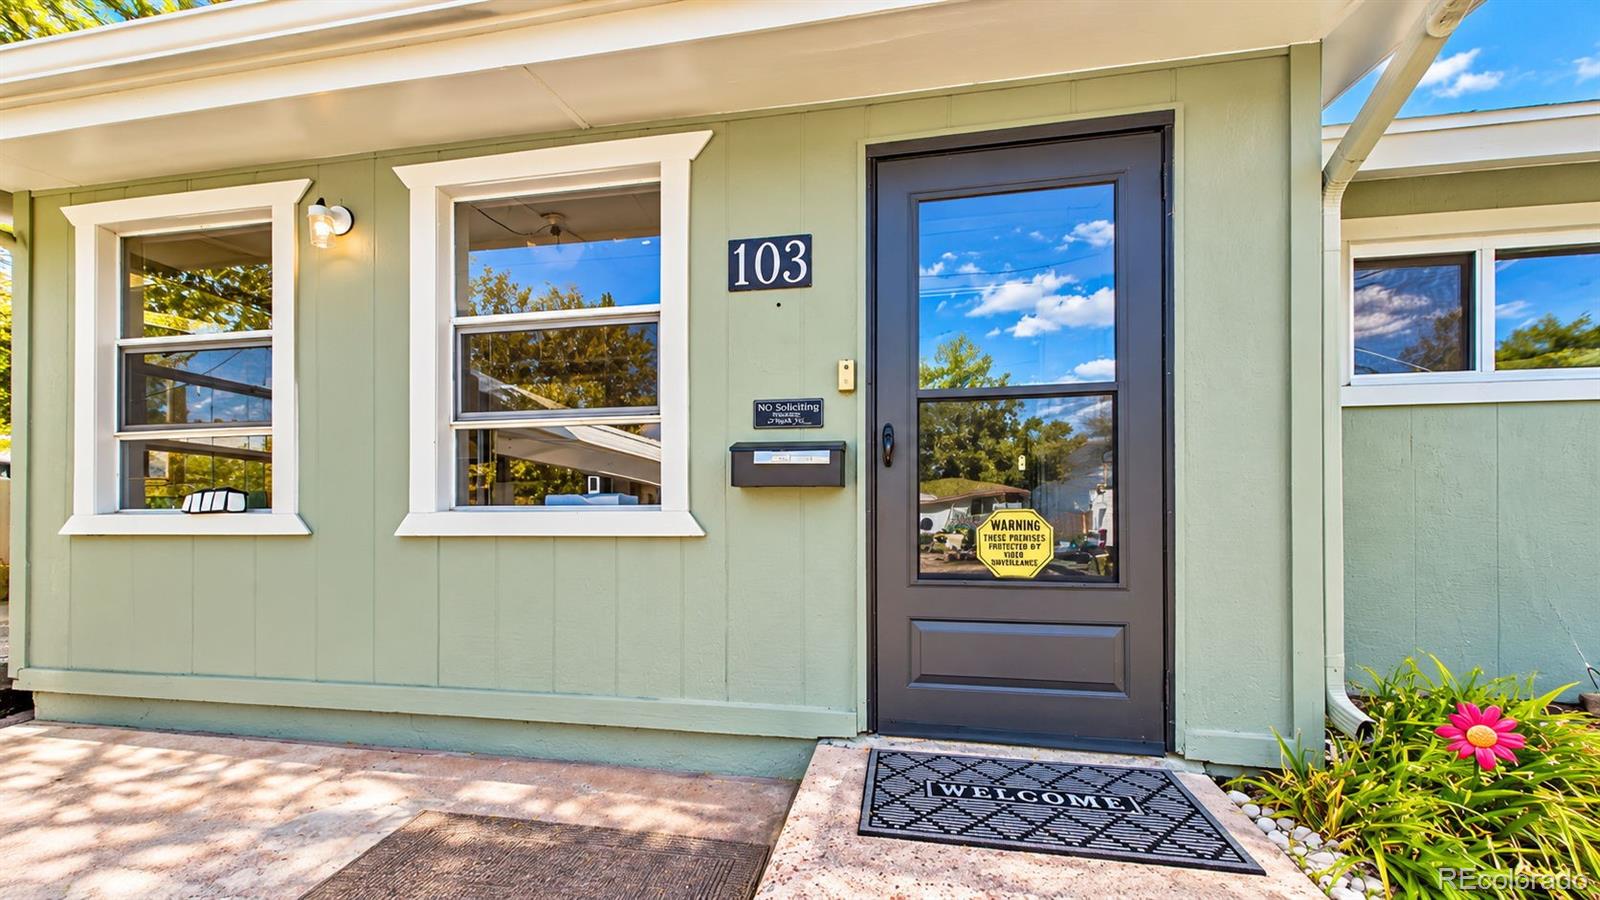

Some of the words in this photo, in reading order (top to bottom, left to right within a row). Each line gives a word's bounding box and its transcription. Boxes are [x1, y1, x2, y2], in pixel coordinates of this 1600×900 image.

[733, 239, 807, 286] 103
[757, 403, 773, 412] NO
[775, 402, 820, 413] Soliciting
[990, 519, 1041, 532] WARNING
[983, 533, 1006, 542] THESE
[1009, 533, 1046, 542] PREMISES
[988, 543, 1028, 551] PROTECTED
[1030, 543, 1042, 551] BY
[1003, 551, 1024, 559] VIDEO
[938, 783, 1126, 810] WELCOME
